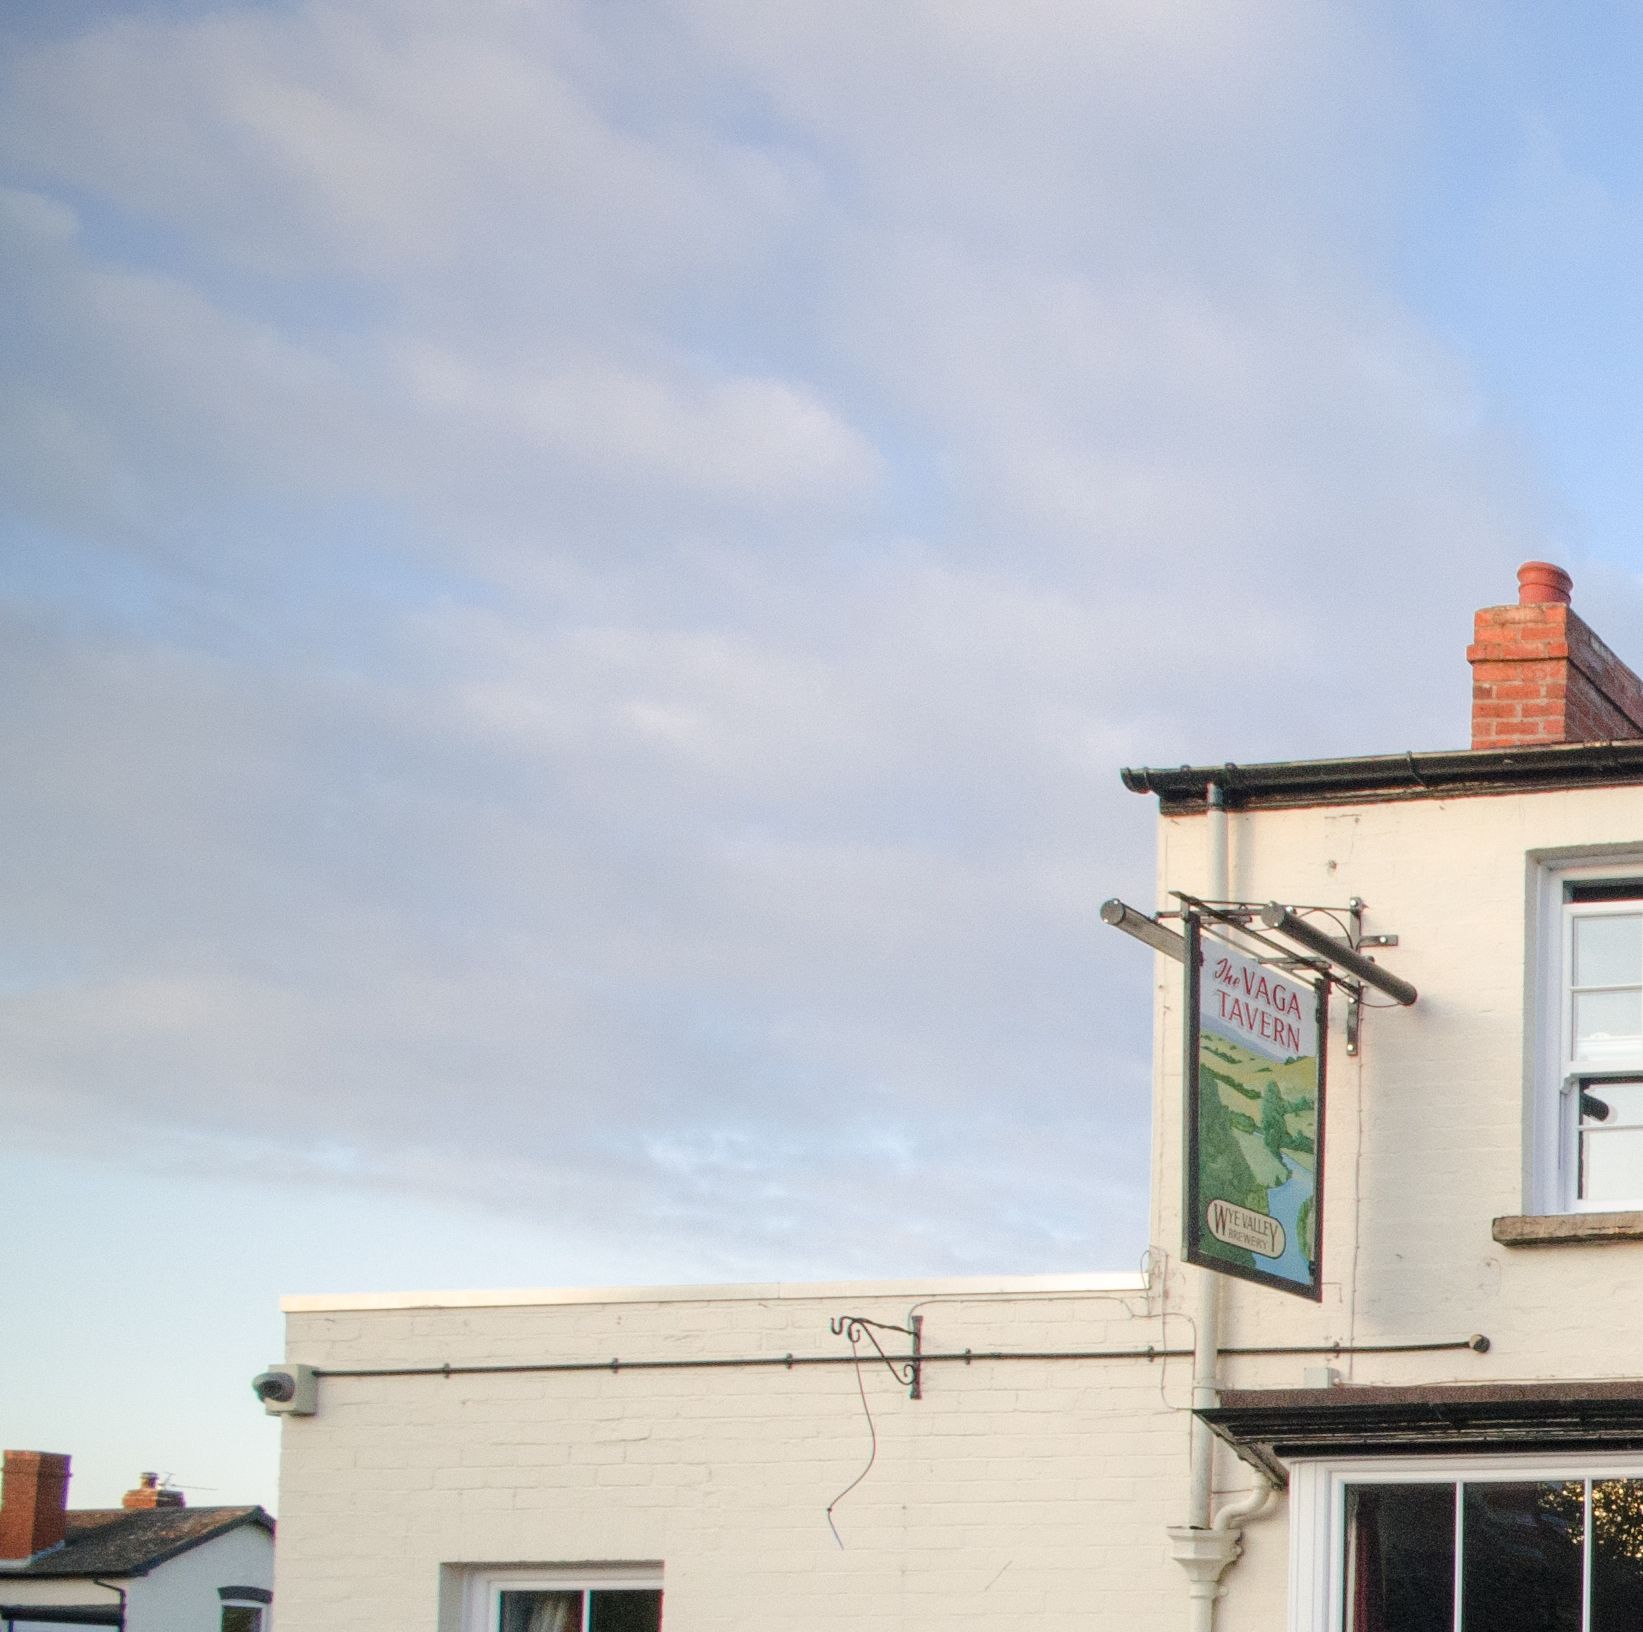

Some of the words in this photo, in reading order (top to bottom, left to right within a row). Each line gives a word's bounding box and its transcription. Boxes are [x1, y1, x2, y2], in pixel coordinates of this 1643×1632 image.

[1214, 957, 1241, 989] The
[1242, 966, 1302, 1021] VAGA
[1217, 990, 1299, 1051] TAVERN
[1214, 1203, 1240, 1236] WYE
[1242, 1213, 1278, 1252] VALLEY
[1229, 1228, 1267, 1249] BREWERY
